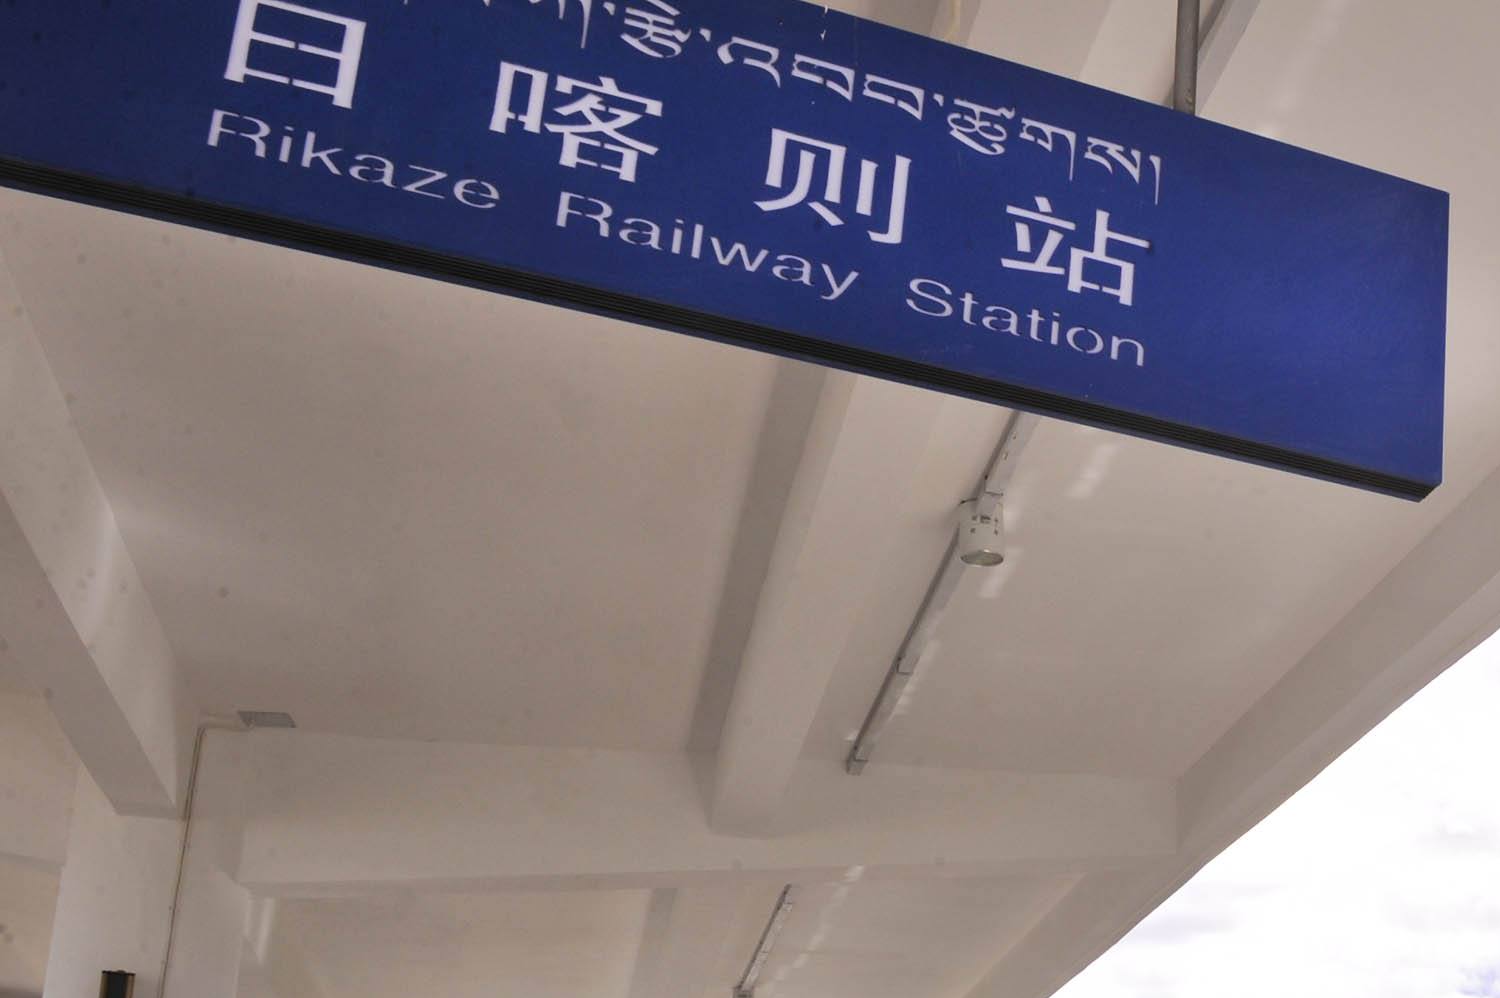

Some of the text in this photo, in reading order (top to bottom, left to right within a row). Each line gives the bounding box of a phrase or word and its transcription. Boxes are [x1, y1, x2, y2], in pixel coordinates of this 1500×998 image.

[208, 110, 1145, 367] Rikaze Railway Station
[224, 0, 1150, 306] 日喀则站
